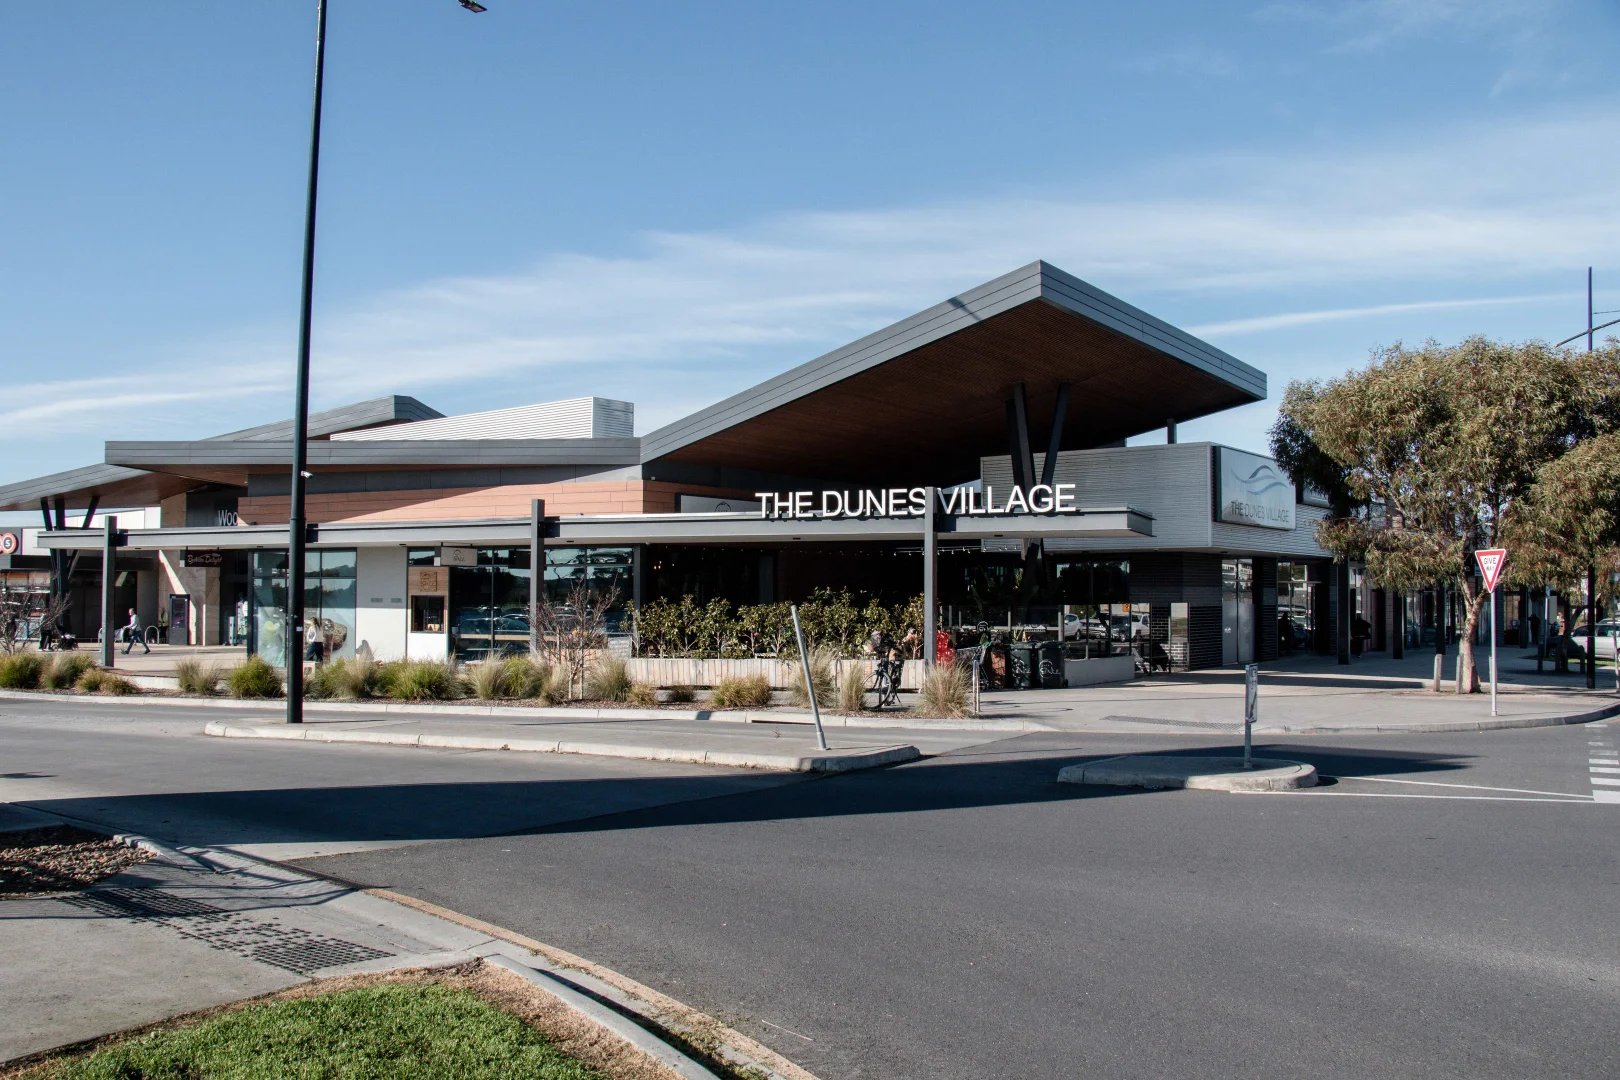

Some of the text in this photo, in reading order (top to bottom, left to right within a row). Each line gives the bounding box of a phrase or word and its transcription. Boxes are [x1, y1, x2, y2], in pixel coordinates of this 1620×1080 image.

[755, 484, 1077, 518] THE DUNES VILLAGE
[1231, 501, 1289, 522] THE DUNES VILLAGE
